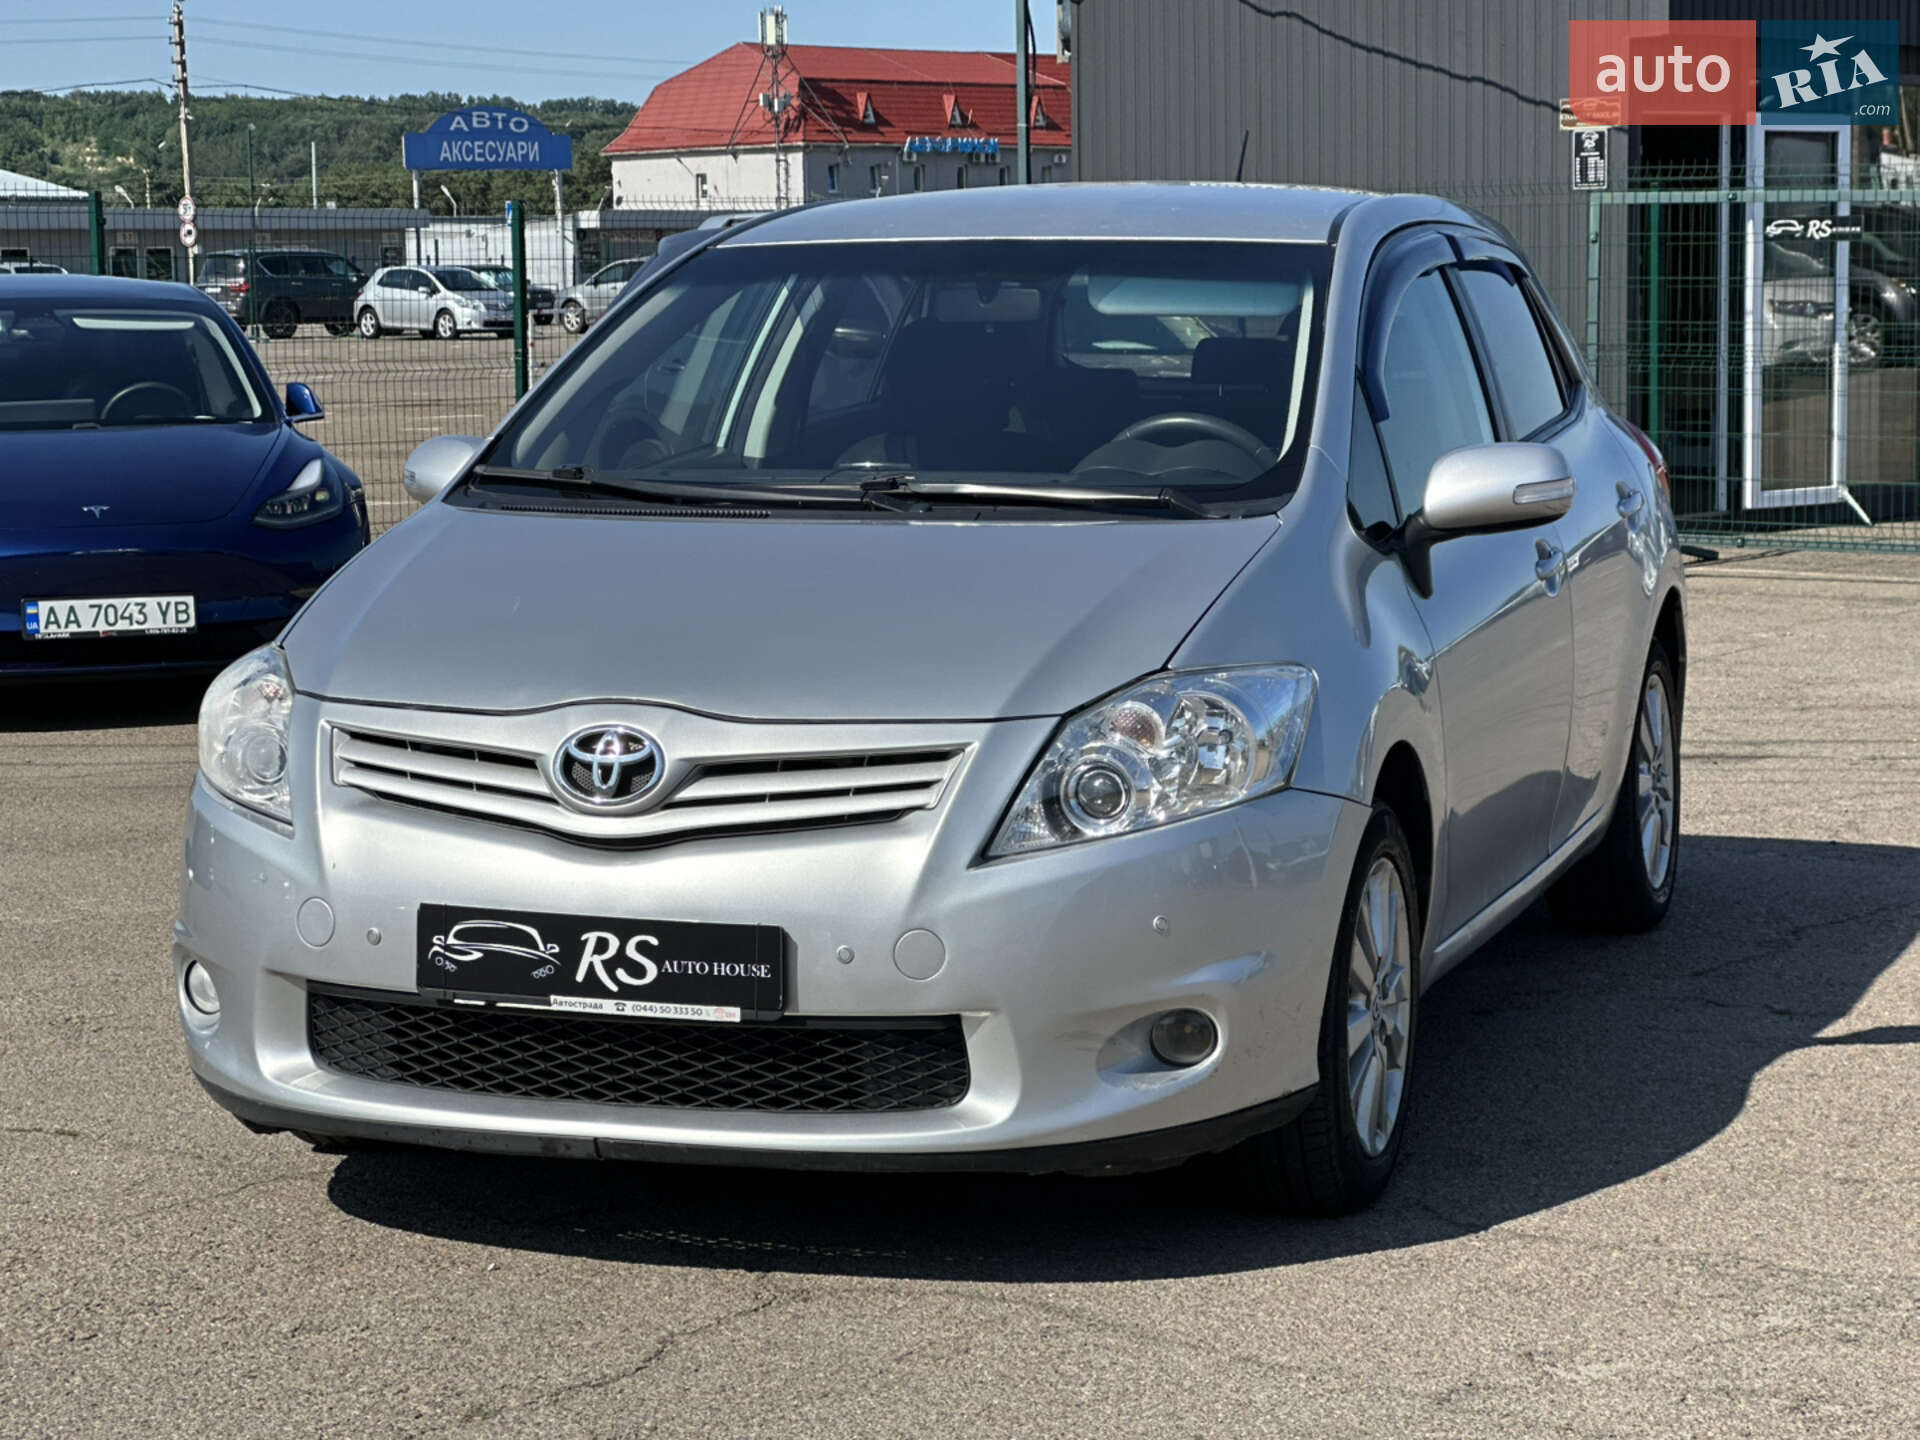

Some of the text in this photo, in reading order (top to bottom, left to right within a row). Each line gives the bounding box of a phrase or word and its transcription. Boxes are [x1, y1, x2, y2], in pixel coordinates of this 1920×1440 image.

[449, 111, 529, 133] АВТО
[439, 141, 540, 162] АКСЕСУАРИ
[1806, 219, 1832, 240] RS
[44, 600, 190, 630] AA 7043 YB
[26, 622, 39, 630] UA
[575, 930, 772, 993] RS AUTO HOUSE
[552, 998, 604, 1011] Автострада
[631, 1003, 658, 1014] (044)
